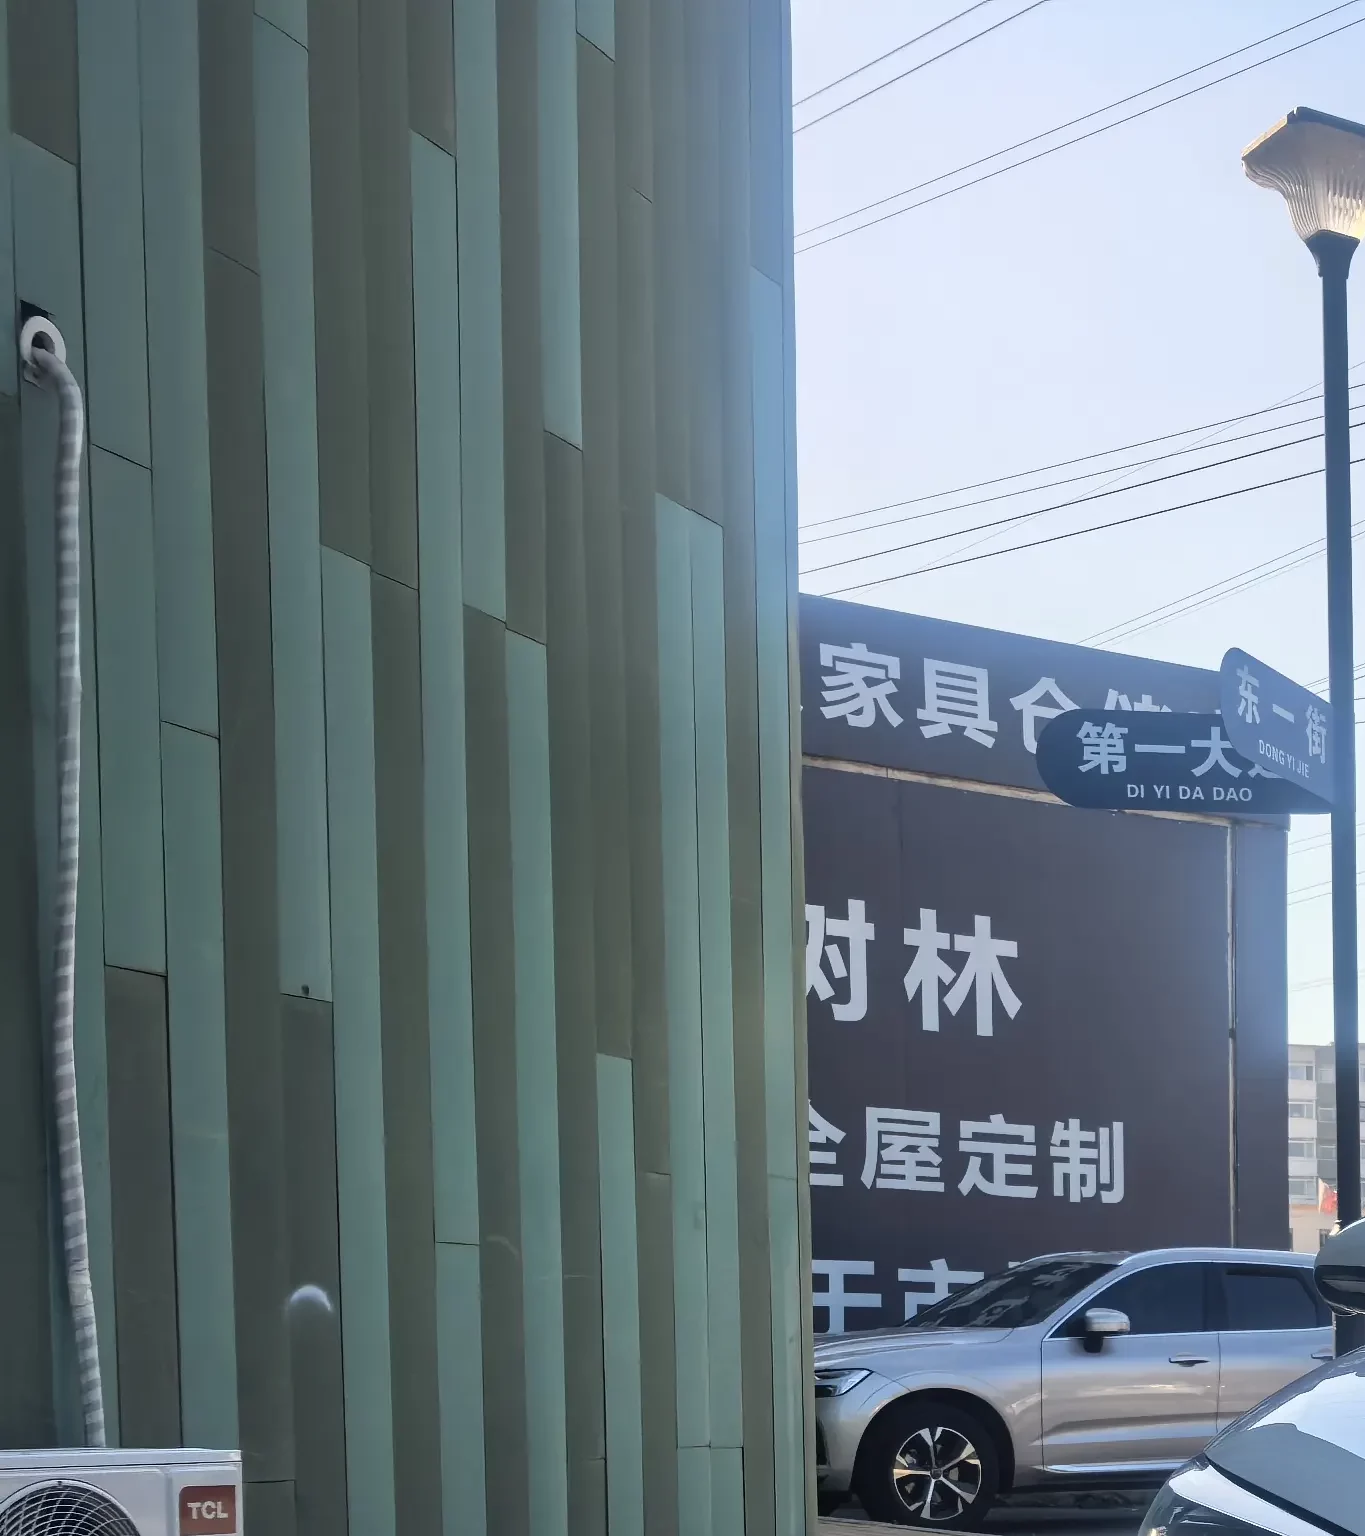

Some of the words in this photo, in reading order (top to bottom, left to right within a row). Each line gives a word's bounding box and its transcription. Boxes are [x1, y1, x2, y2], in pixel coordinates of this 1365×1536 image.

[1236, 665, 1328, 765] 东一街
[1076, 721, 1285, 779] 第一大
[1259, 739, 1285, 766] DONG
[1286, 756, 1296, 772] YI
[1296, 760, 1310, 779] JIE
[1127, 783, 1145, 799] DI
[1153, 784, 1171, 799] YI
[1178, 785, 1205, 800] DA
[1212, 786, 1253, 802] DAO
[811, 1258, 1024, 1334] 于市
[186, 1500, 229, 1520] TCL
